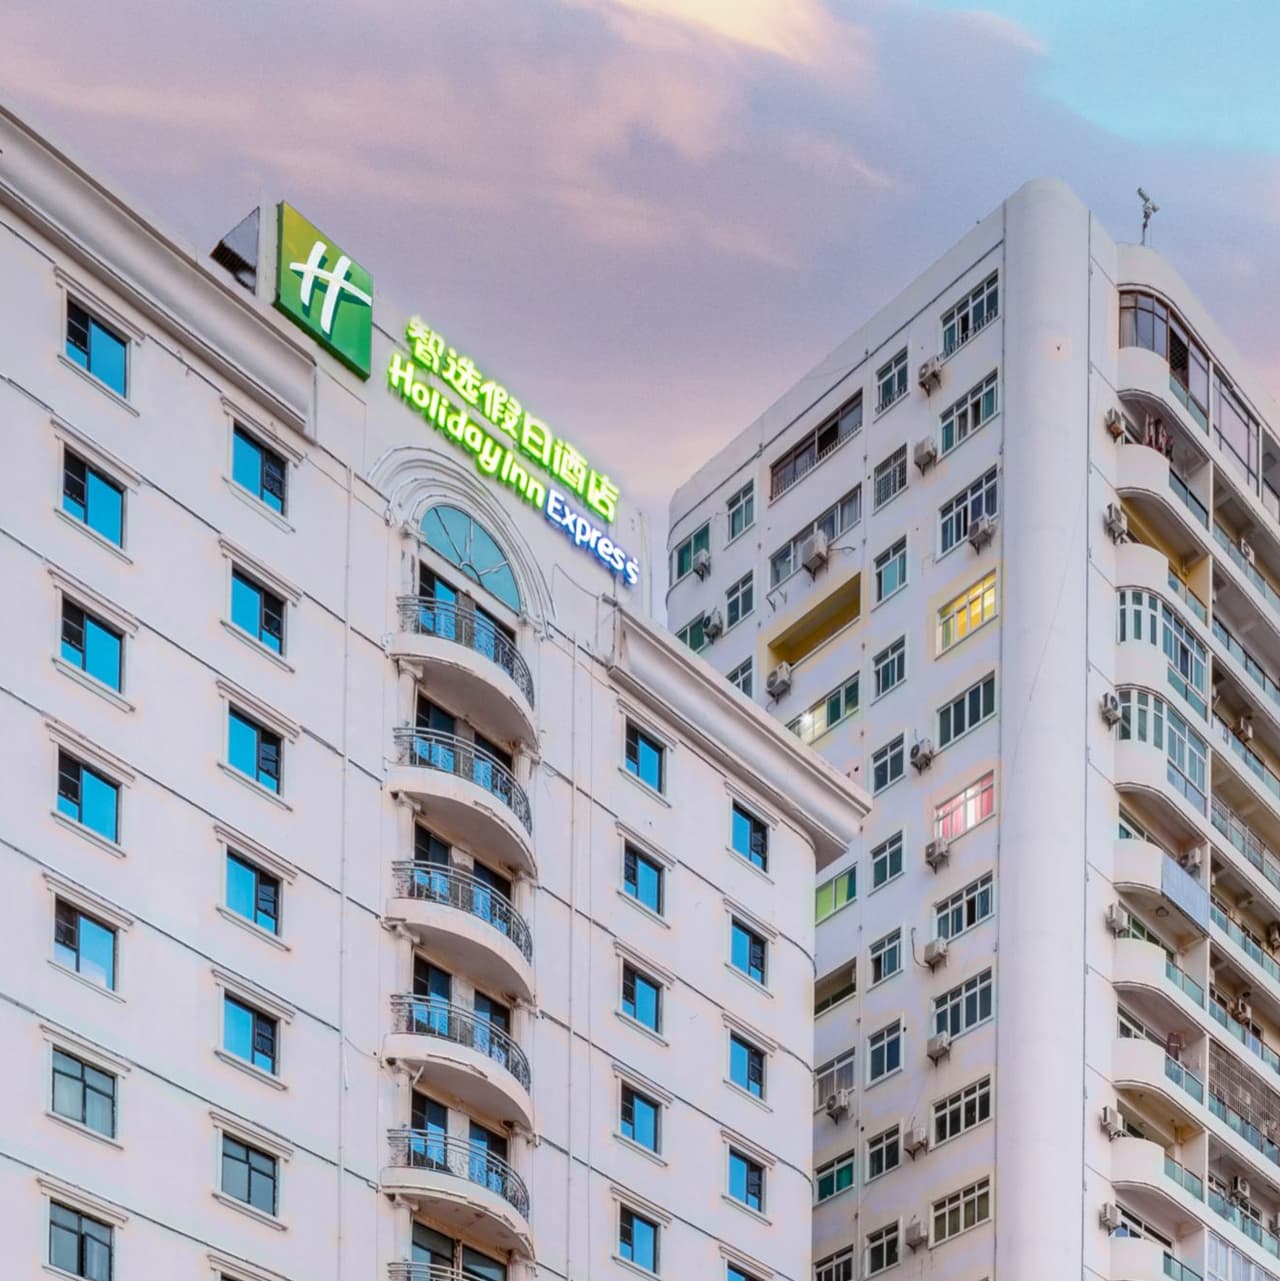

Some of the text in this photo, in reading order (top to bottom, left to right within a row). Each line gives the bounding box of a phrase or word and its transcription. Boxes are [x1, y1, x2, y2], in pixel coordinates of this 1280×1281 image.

[388, 352, 640, 586] Holiday Inn Express
[407, 316, 618, 524] 智选假日酒店
